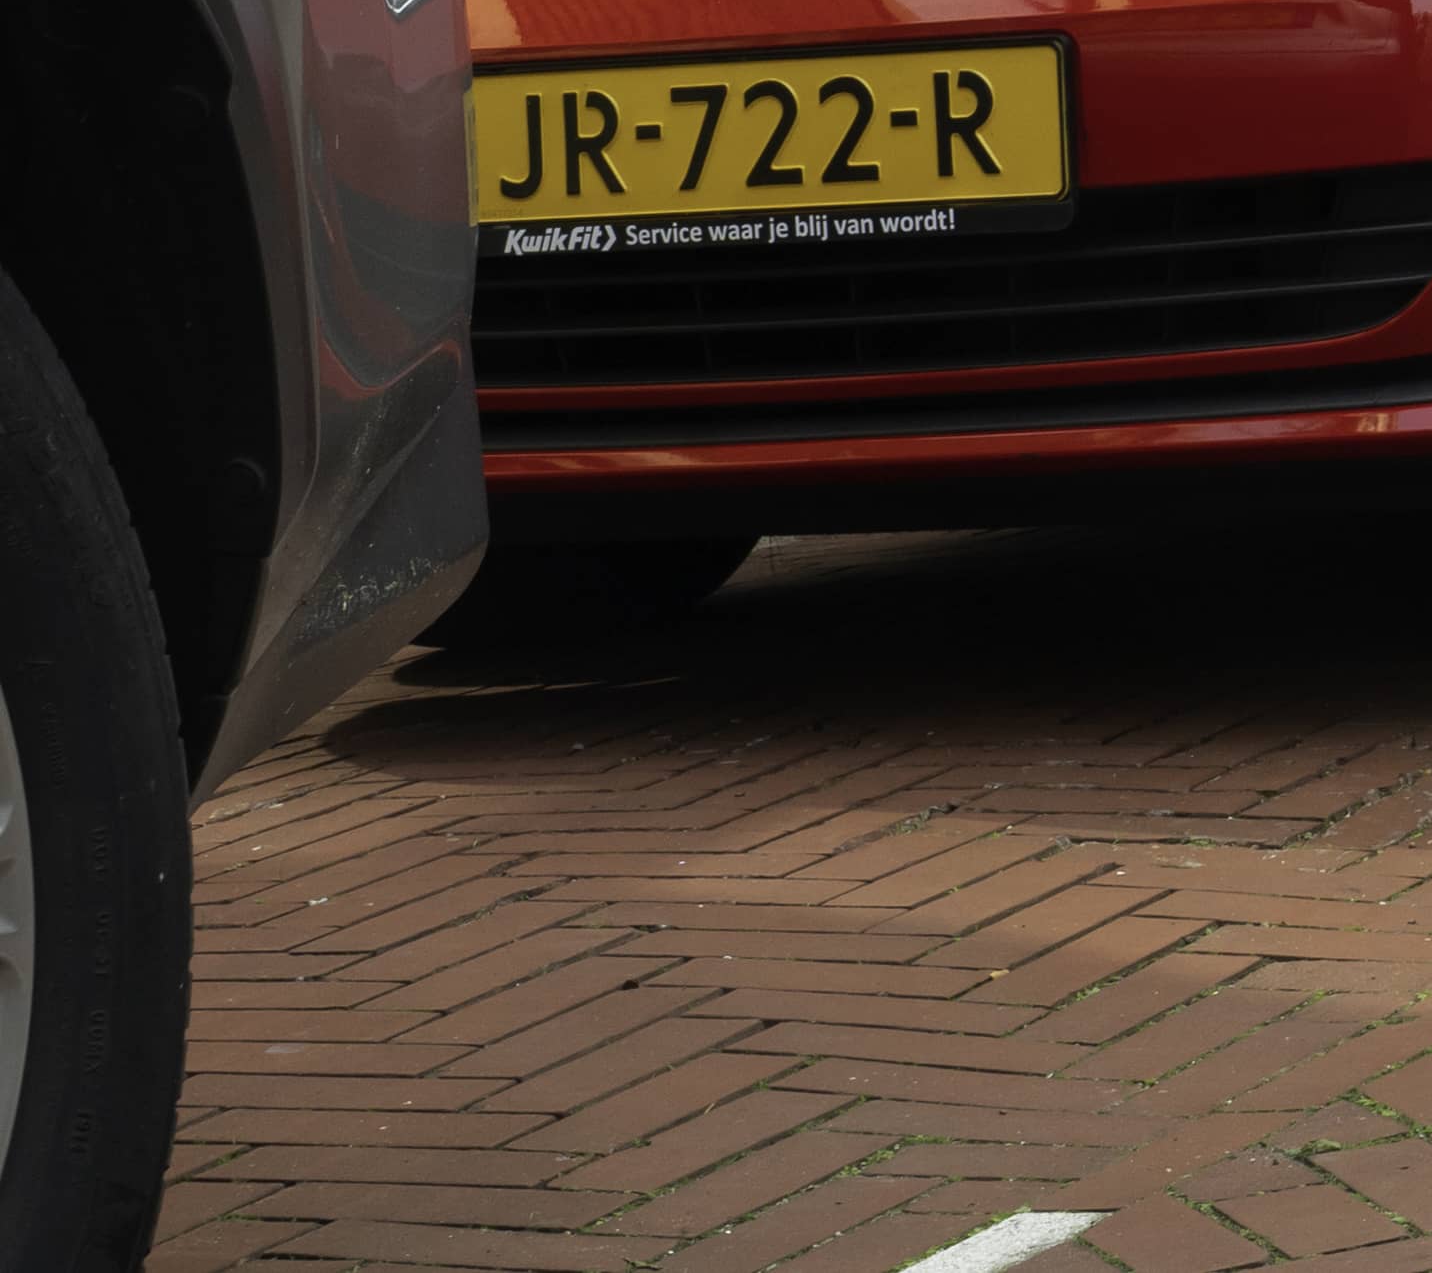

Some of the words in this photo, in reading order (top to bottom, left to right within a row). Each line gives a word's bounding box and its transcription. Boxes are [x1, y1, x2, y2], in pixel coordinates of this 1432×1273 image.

[501, 70, 1002, 198] JR-722-R
[626, 223, 702, 245] Service
[709, 223, 763, 241] waar
[768, 217, 790, 244] je
[794, 211, 829, 241] blij
[834, 218, 874, 235] van
[879, 208, 956, 233] wordt!
